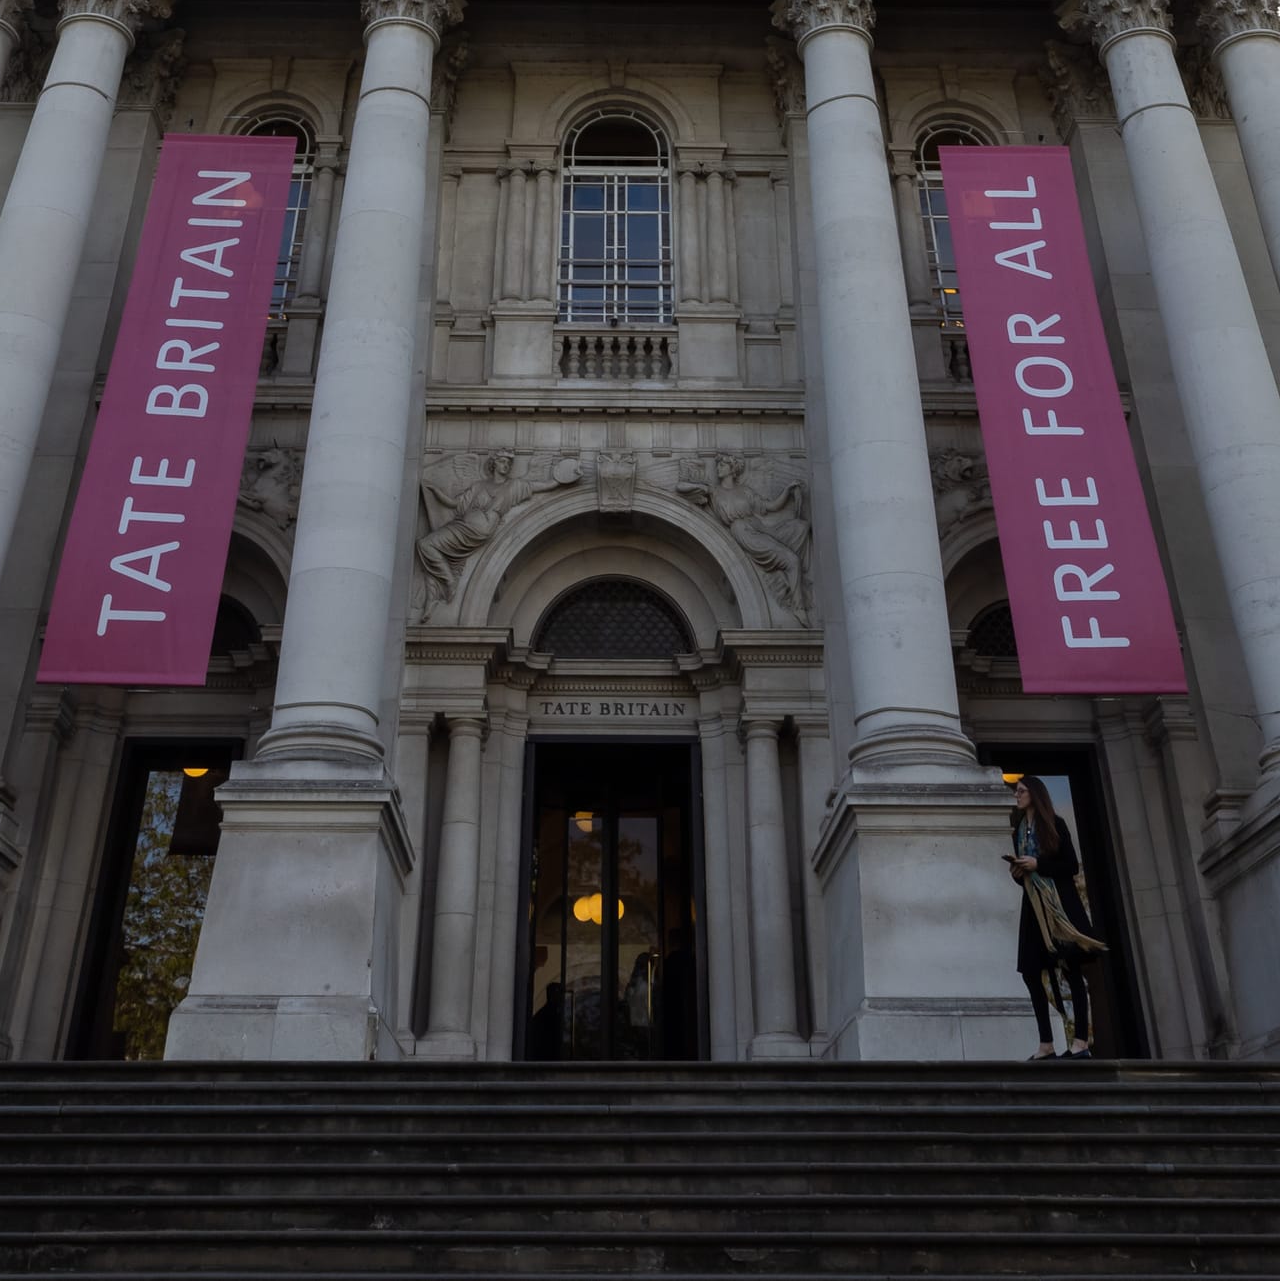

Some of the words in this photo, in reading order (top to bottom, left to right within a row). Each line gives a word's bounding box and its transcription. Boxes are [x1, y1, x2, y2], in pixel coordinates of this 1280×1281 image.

[145, 169, 252, 418] BRITAIN
[983, 175, 1054, 280] ALL
[1007, 312, 1085, 436] FOR
[96, 455, 196, 637] TATE
[1035, 476, 1131, 648] FREE
[540, 702, 592, 716] TATE
[599, 702, 686, 716] BRITAIN
